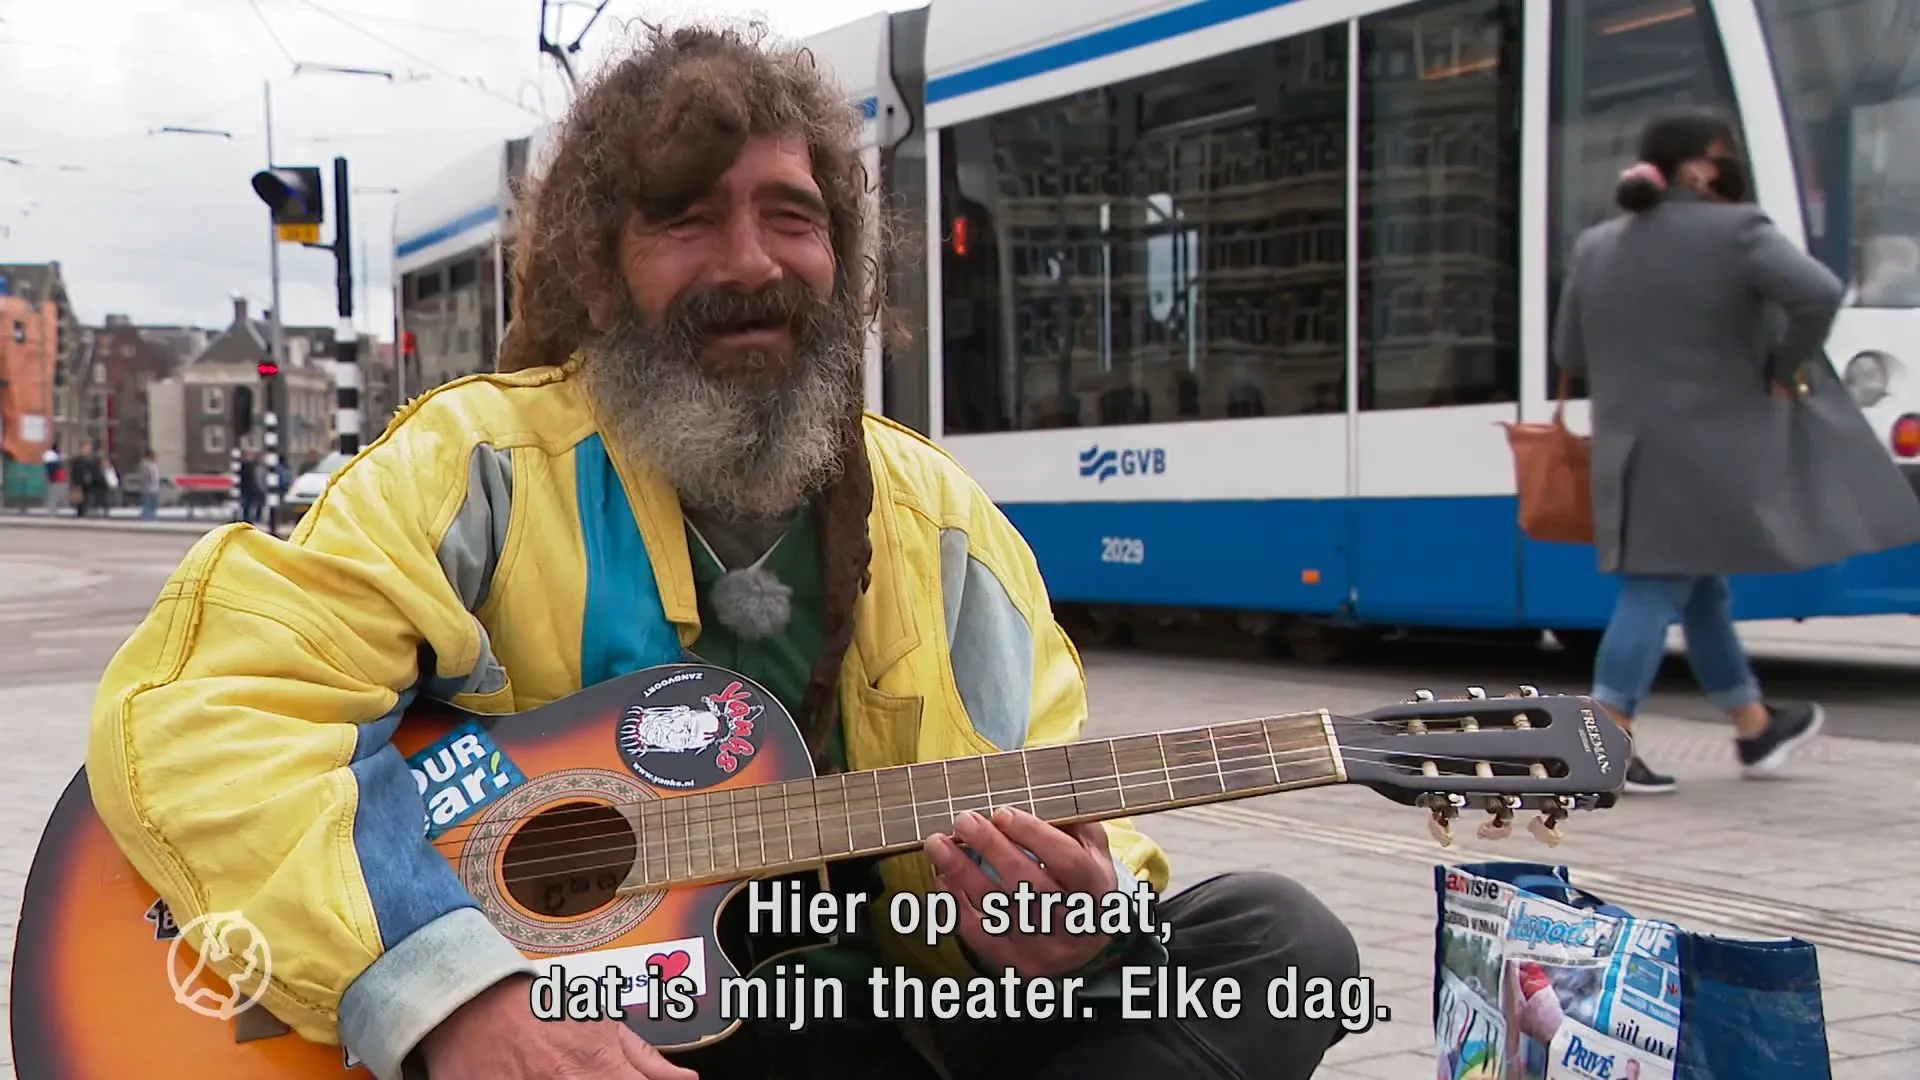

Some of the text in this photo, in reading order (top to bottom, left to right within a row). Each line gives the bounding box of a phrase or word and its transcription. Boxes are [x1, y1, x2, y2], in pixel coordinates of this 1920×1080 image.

[1121, 449, 1166, 475] GVB
[1101, 536, 1145, 564] 2029
[643, 672, 704, 698] ZANDVOORT
[632, 761, 695, 788] www.yanks.nl
